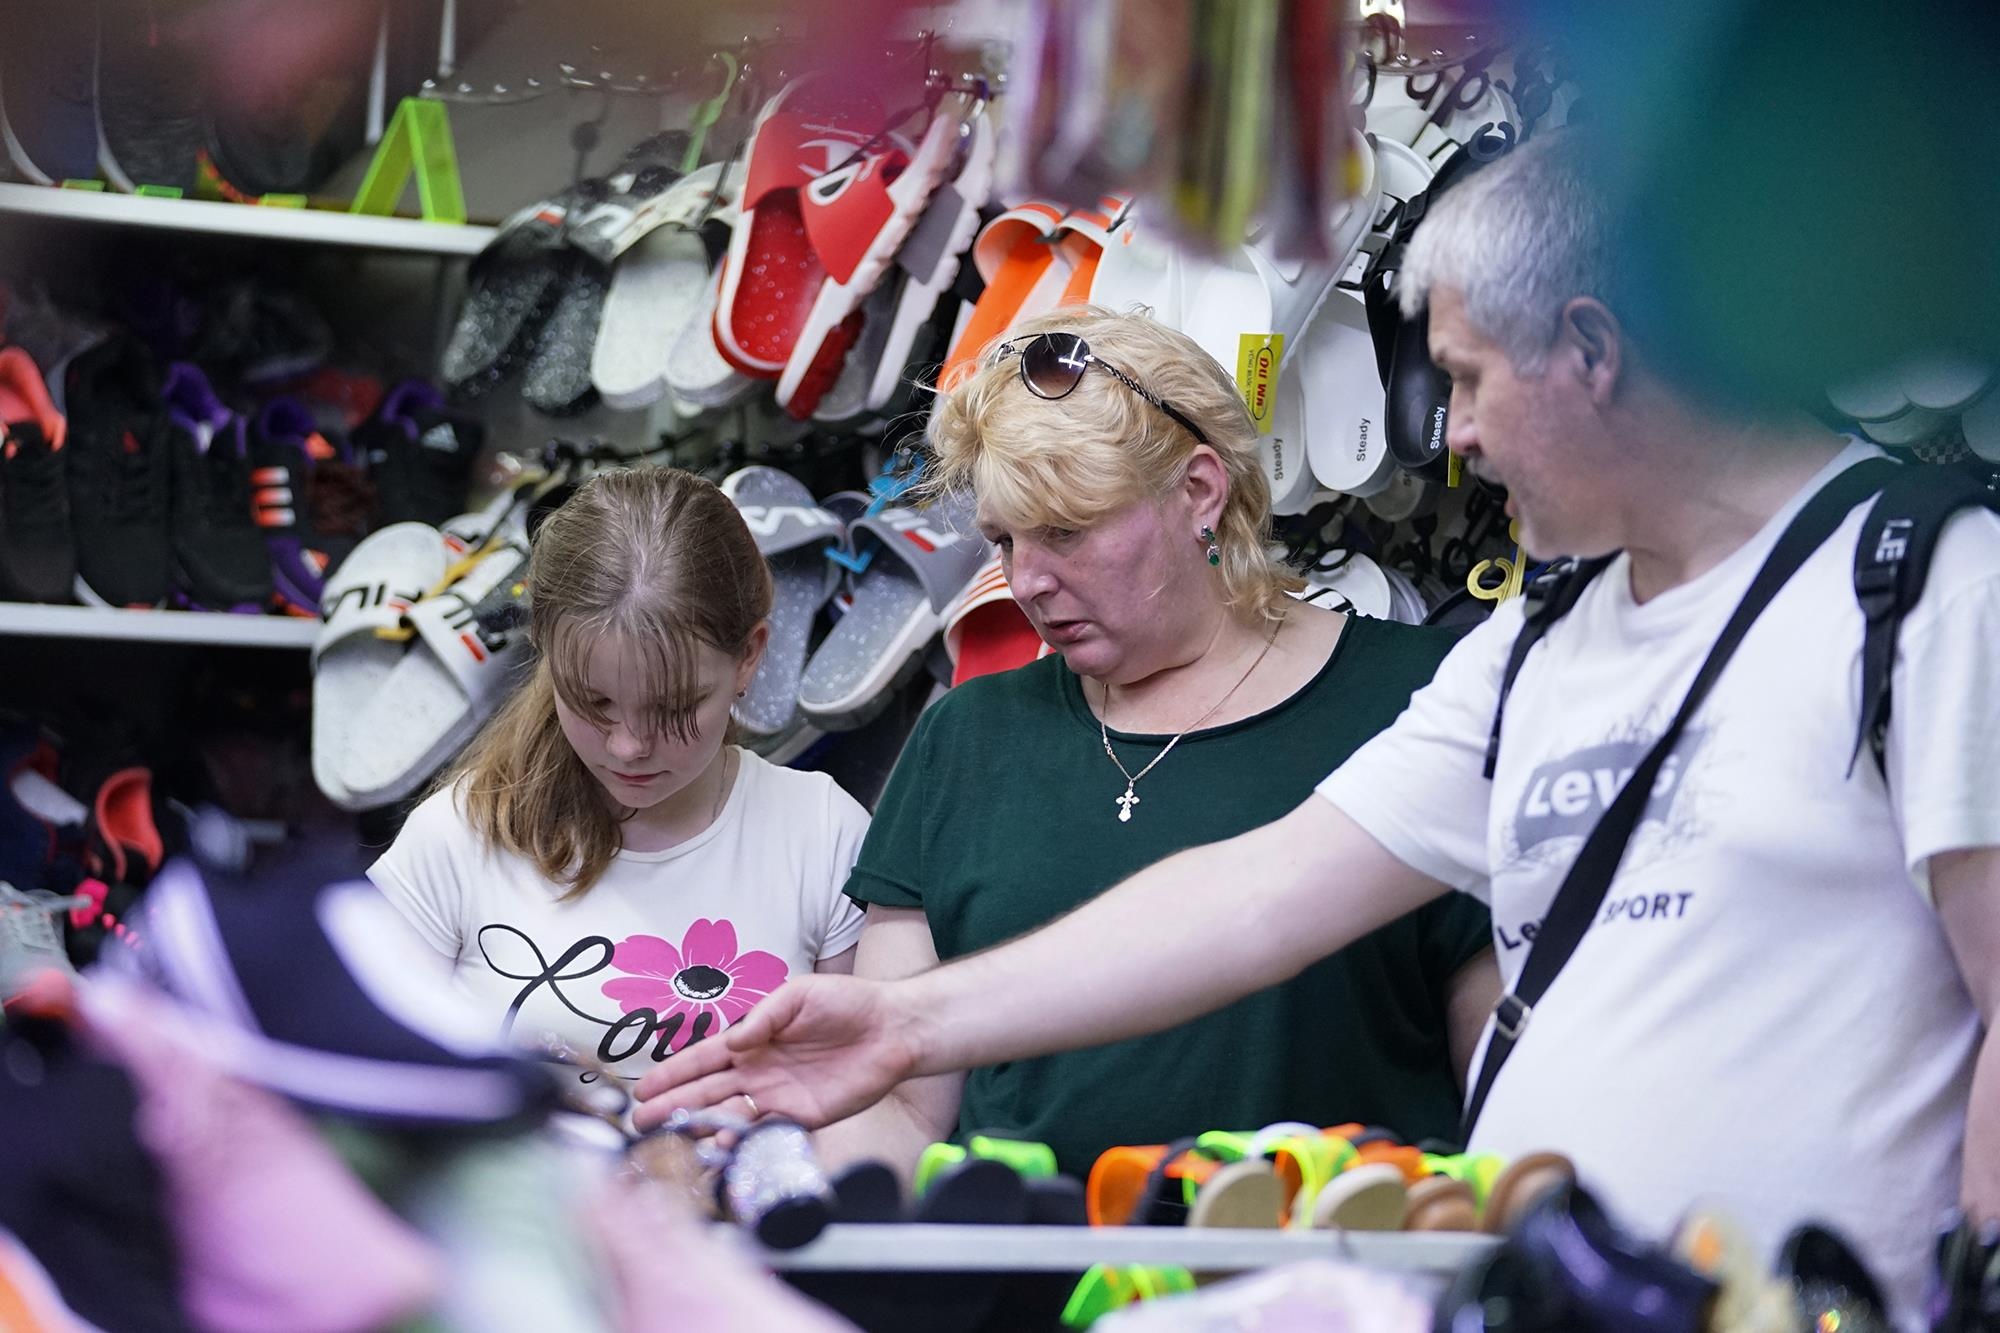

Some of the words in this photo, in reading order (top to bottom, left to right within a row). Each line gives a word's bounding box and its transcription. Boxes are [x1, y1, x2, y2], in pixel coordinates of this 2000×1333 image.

[1356, 418, 1371, 462] Steady
[1430, 406, 1446, 449] Steady
[1274, 437, 1283, 481] Steady
[1875, 518, 1913, 564] LE
[478, 924, 746, 1084] Lov
